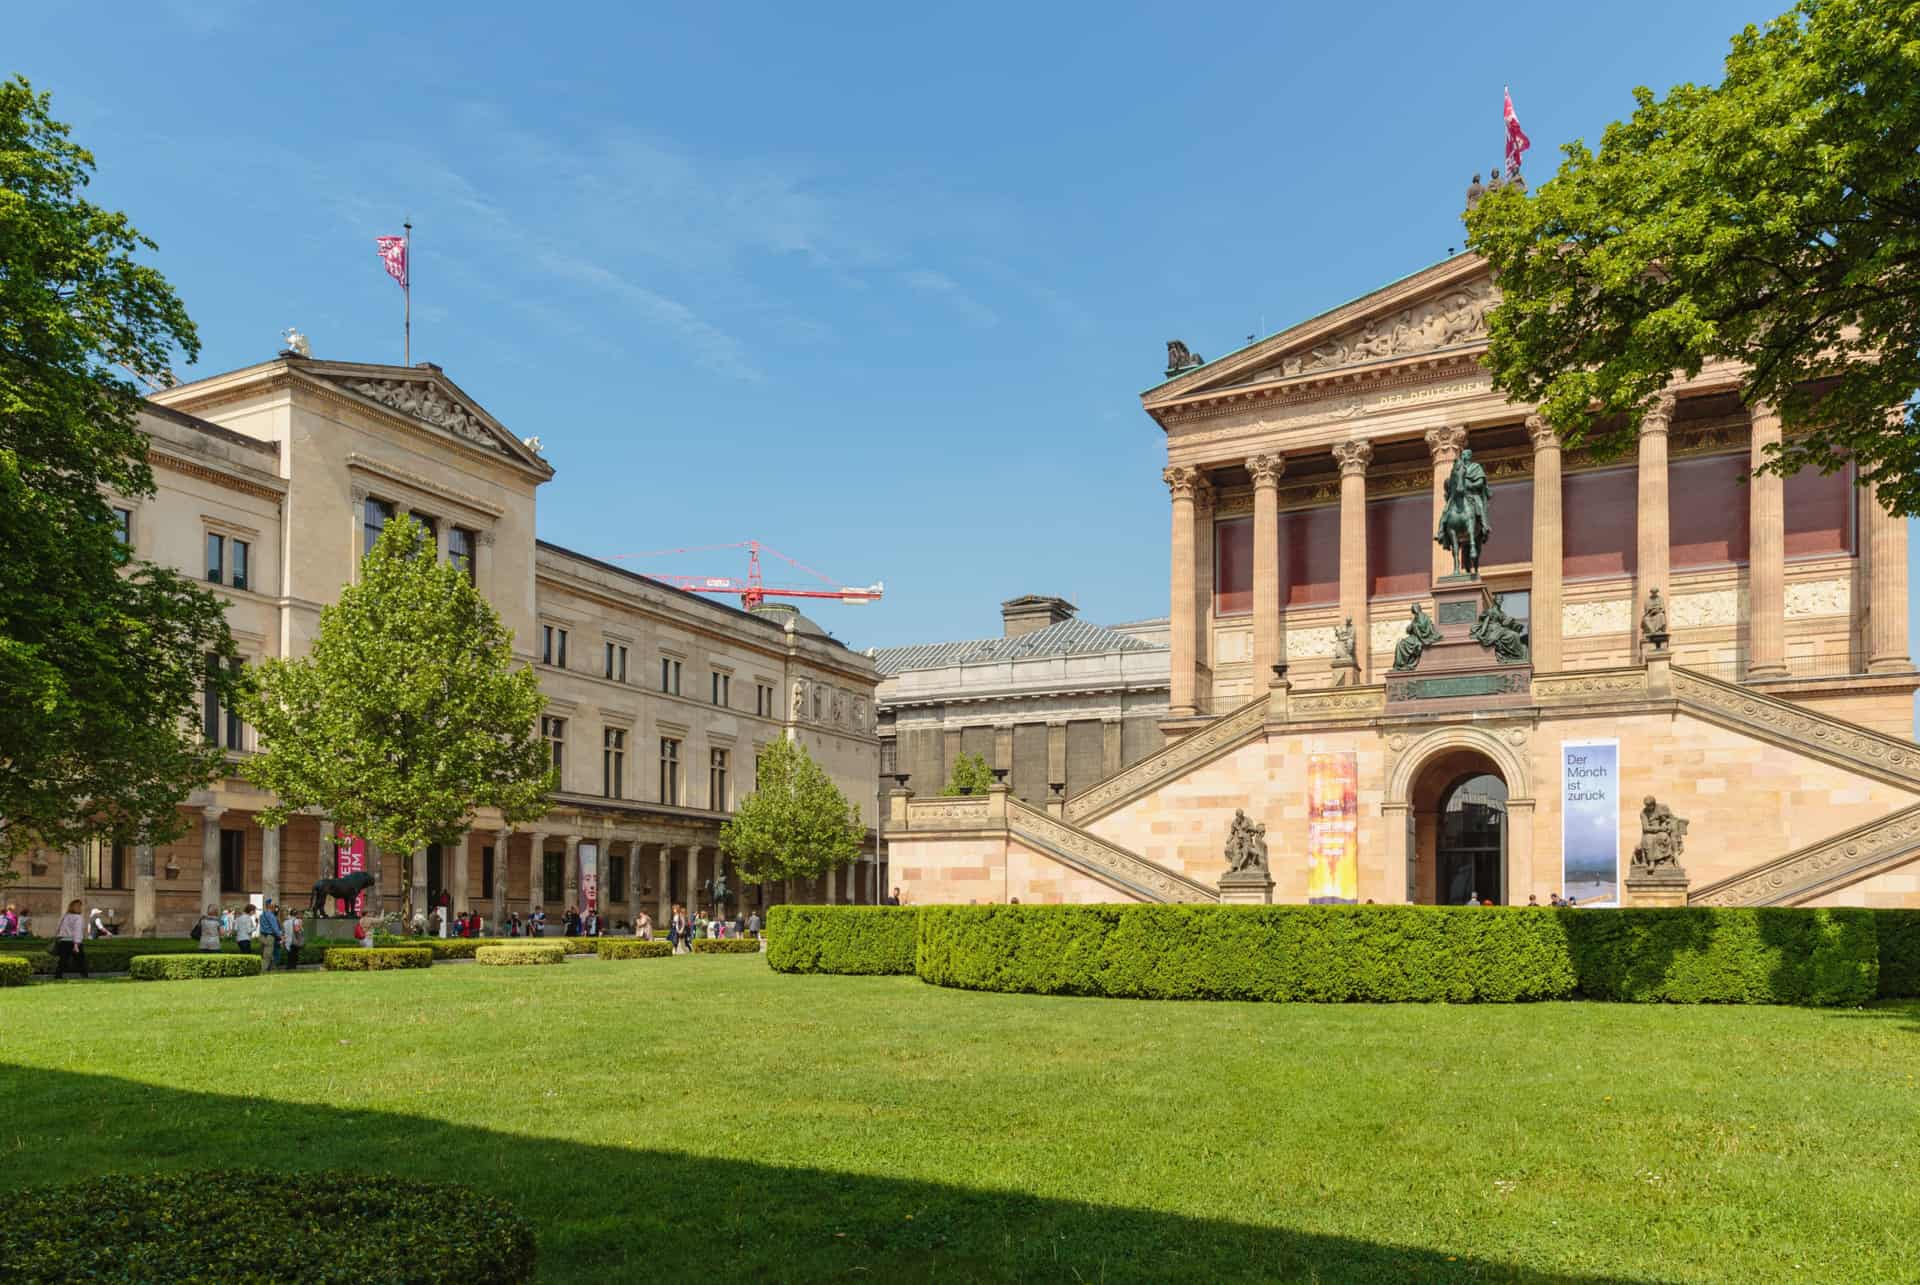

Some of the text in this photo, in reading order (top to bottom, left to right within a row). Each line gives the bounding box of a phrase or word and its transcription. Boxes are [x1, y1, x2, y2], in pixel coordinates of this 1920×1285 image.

[1567, 754, 1587, 765] Der
[1567, 765, 1607, 777] Mönch
[1567, 779, 1581, 791] ist
[340, 836, 352, 879] EUES
